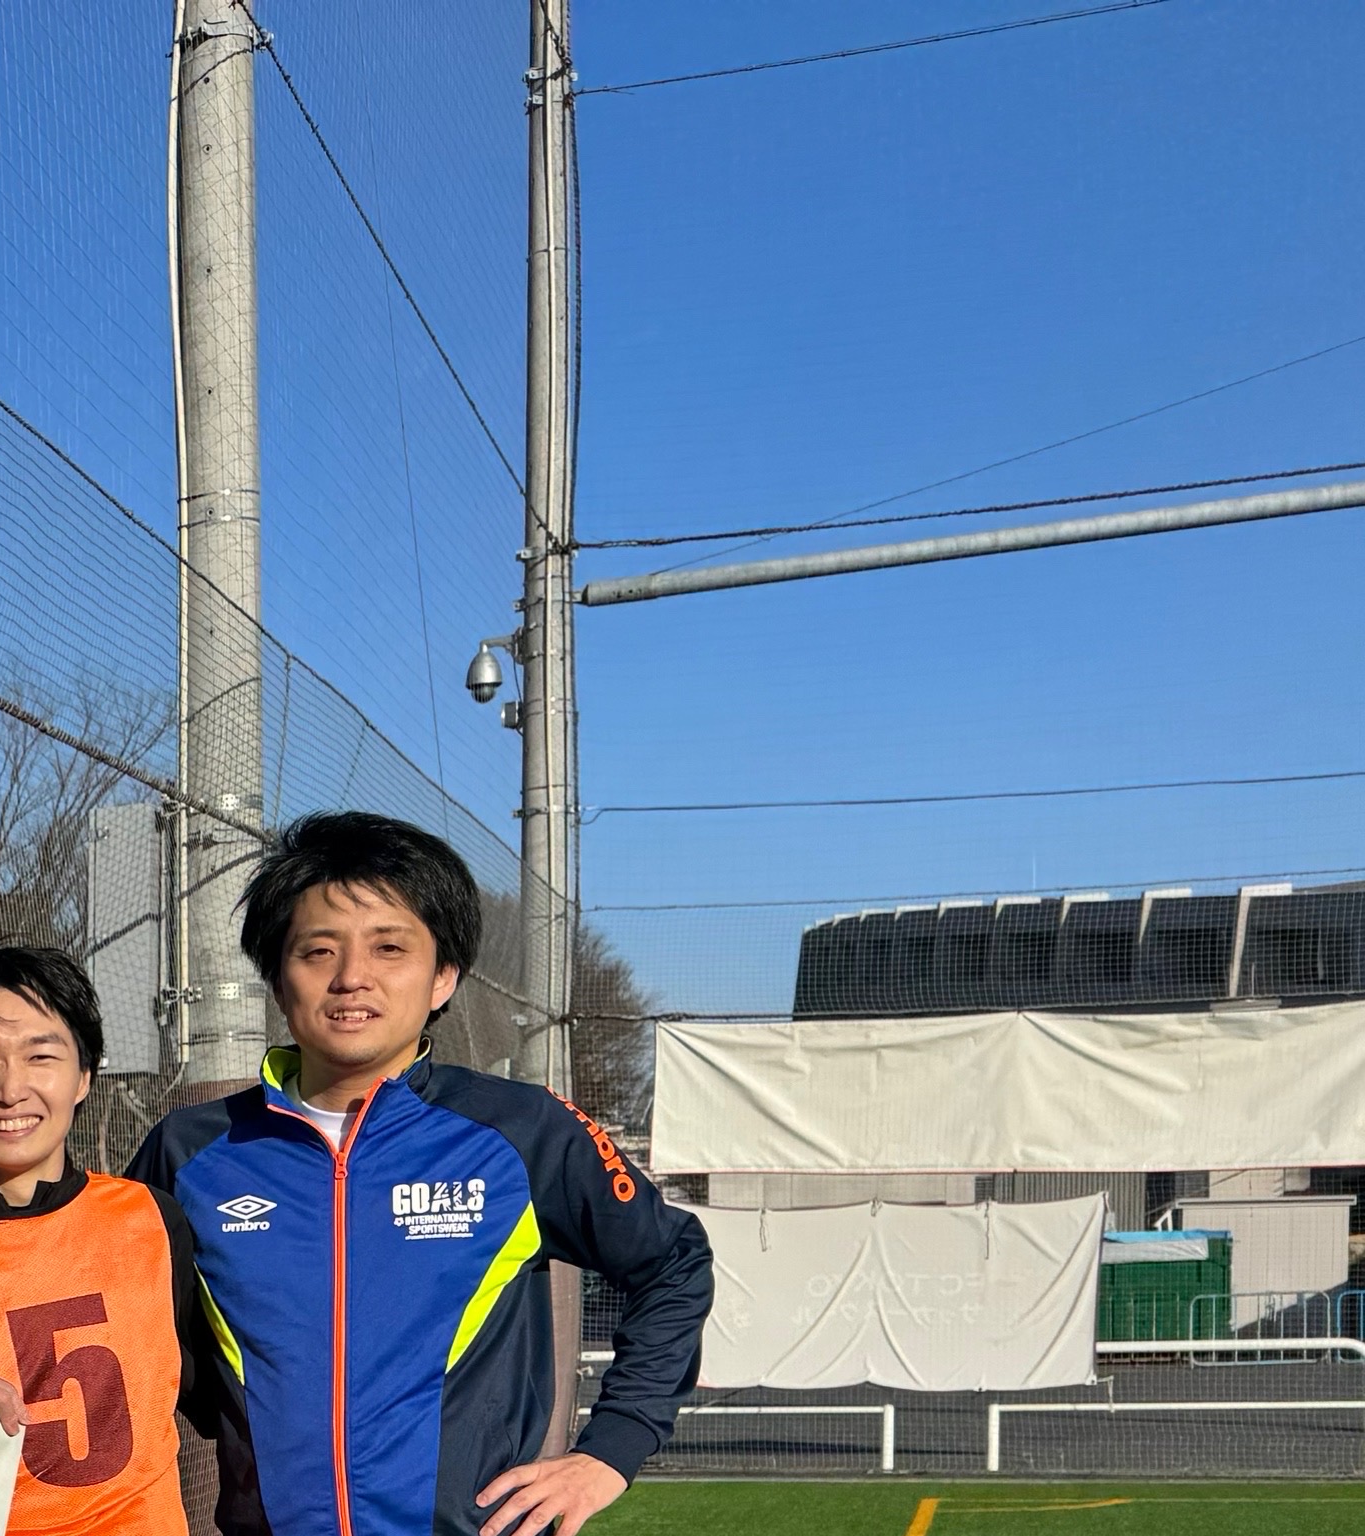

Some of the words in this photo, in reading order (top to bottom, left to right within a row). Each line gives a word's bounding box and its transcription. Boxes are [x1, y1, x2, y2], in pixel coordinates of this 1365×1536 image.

[392, 1178, 486, 1216] GOALS
[404, 1213, 474, 1226] INTERNATIONAL
[222, 1220, 271, 1233] umbro
[408, 1222, 470, 1235] SPORTSWEAR
[6, 1292, 134, 1488] 5
